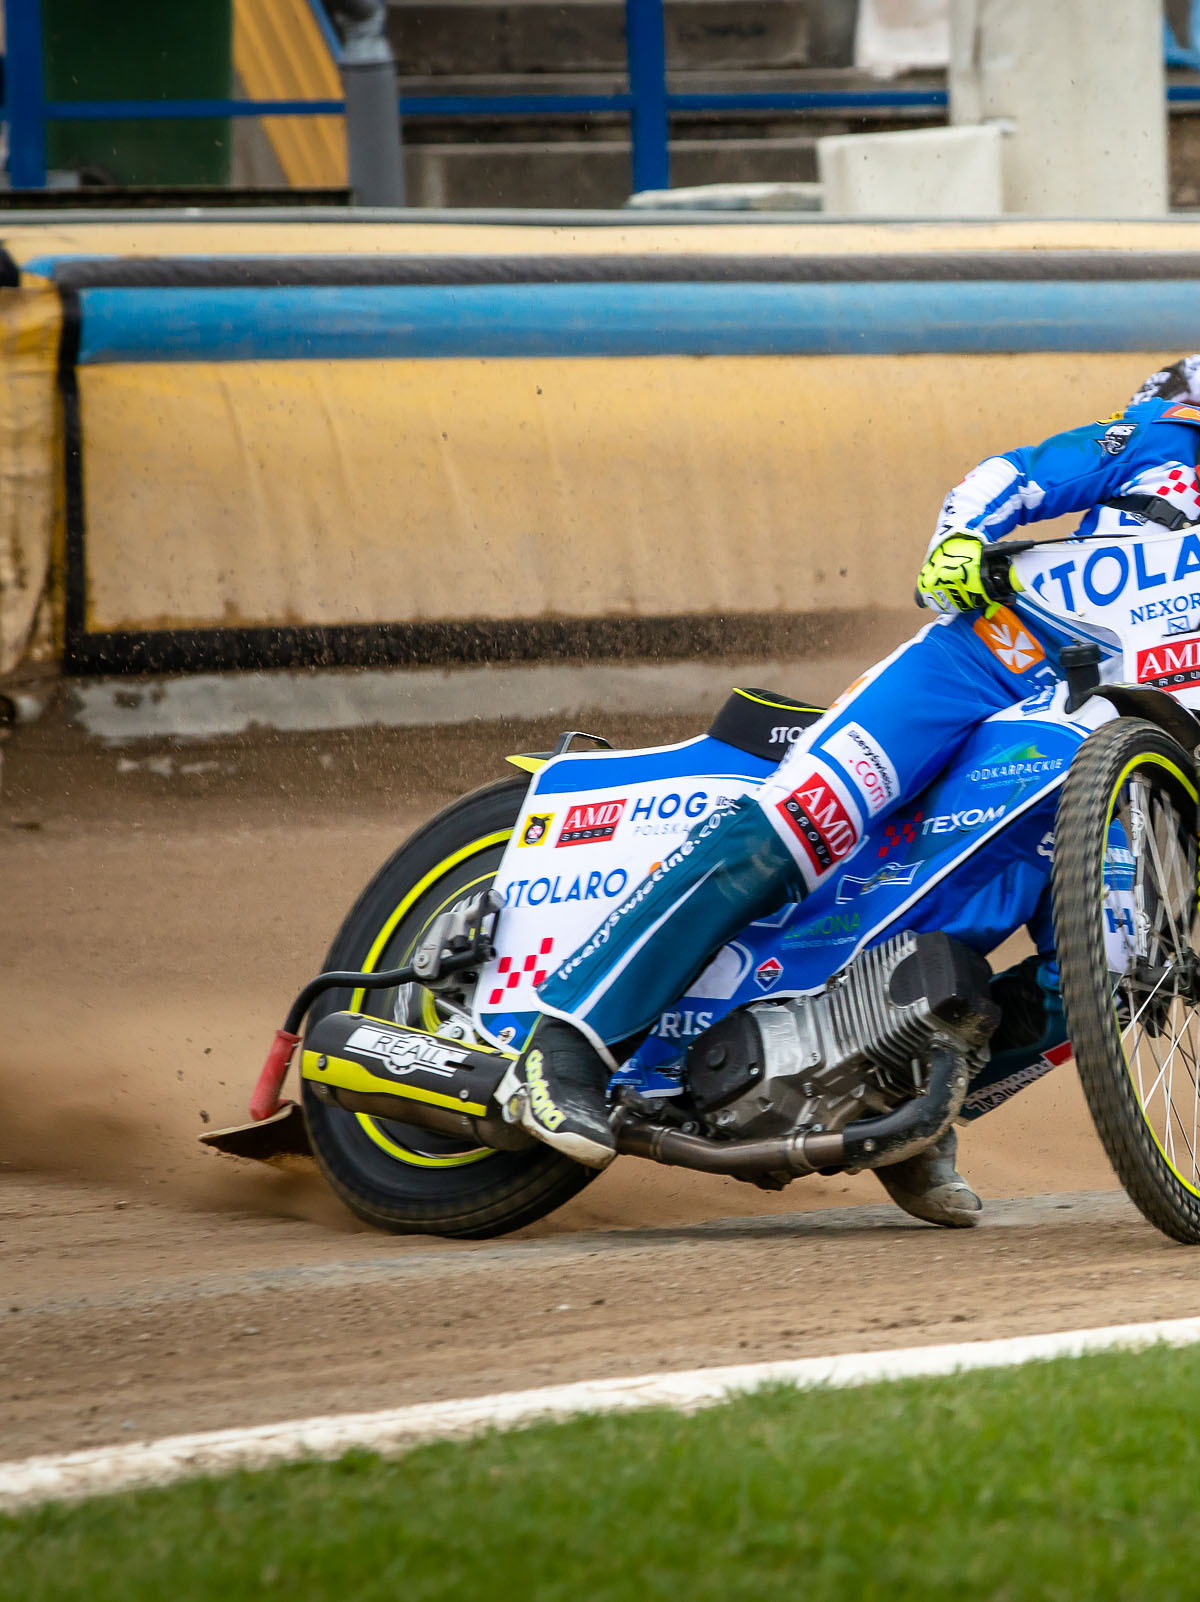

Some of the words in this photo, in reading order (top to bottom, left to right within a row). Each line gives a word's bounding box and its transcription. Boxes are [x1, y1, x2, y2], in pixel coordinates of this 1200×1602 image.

[563, 803, 624, 830] AMD
[629, 791, 709, 822] HOG
[796, 786, 856, 856] AMD
[921, 804, 1007, 836] TEXOM
[503, 867, 628, 908] STOLARO
